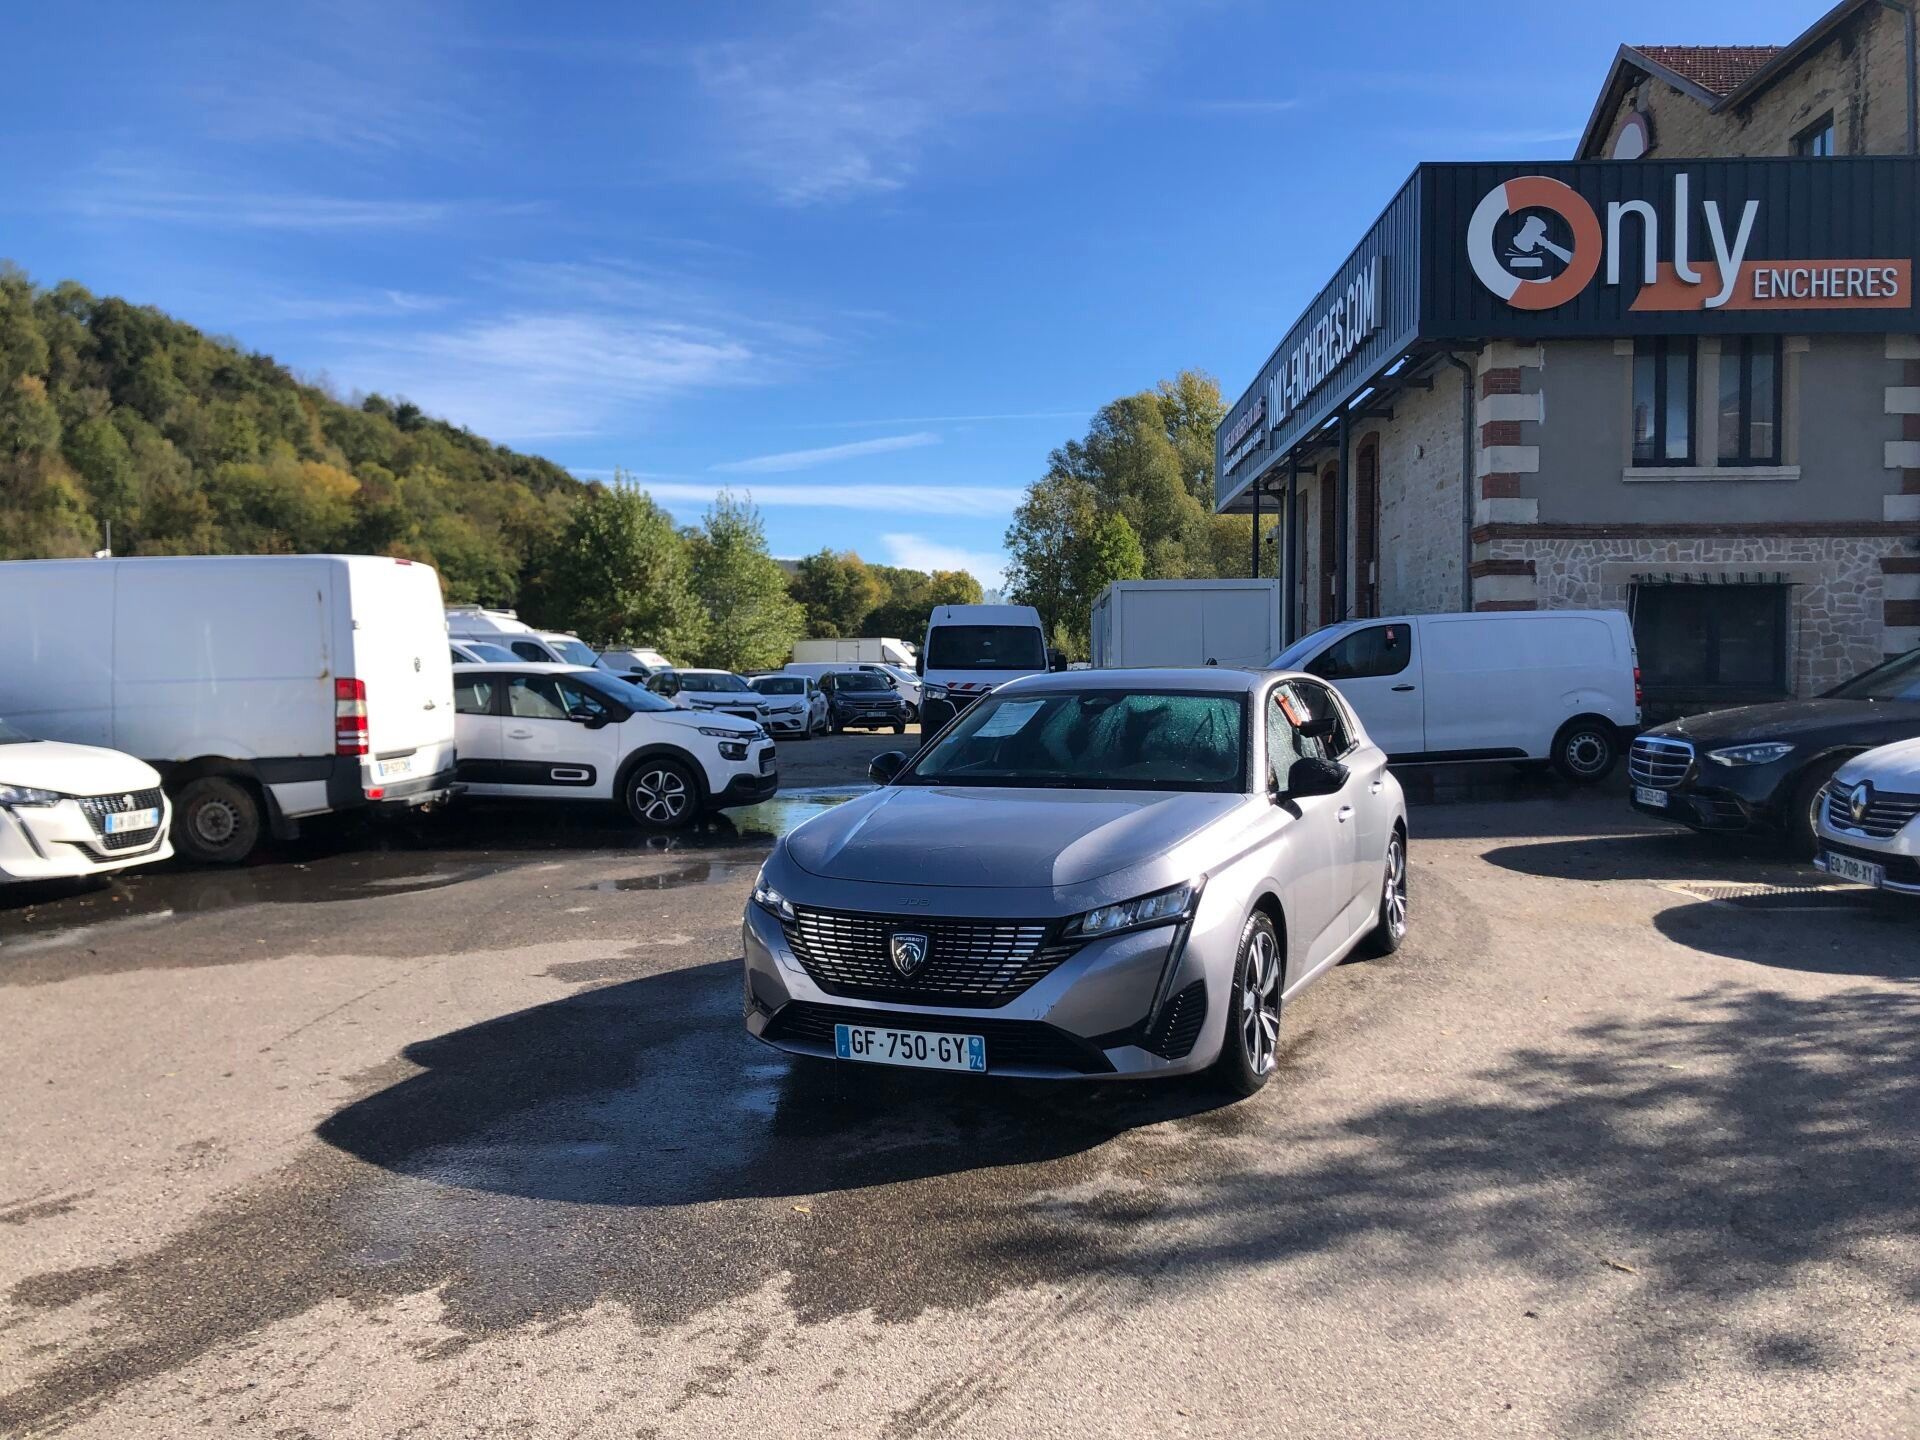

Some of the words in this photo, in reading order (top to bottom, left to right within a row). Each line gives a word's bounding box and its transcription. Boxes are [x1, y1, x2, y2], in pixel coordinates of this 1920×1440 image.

[1467, 173, 1760, 310] Only
[1754, 267, 1898, 298] ENCHERES
[1268, 256, 1376, 432] ONLY-ENCHERES.COM
[851, 1029, 965, 1063] GF-750-GY
[970, 1054, 983, 1068] 74
